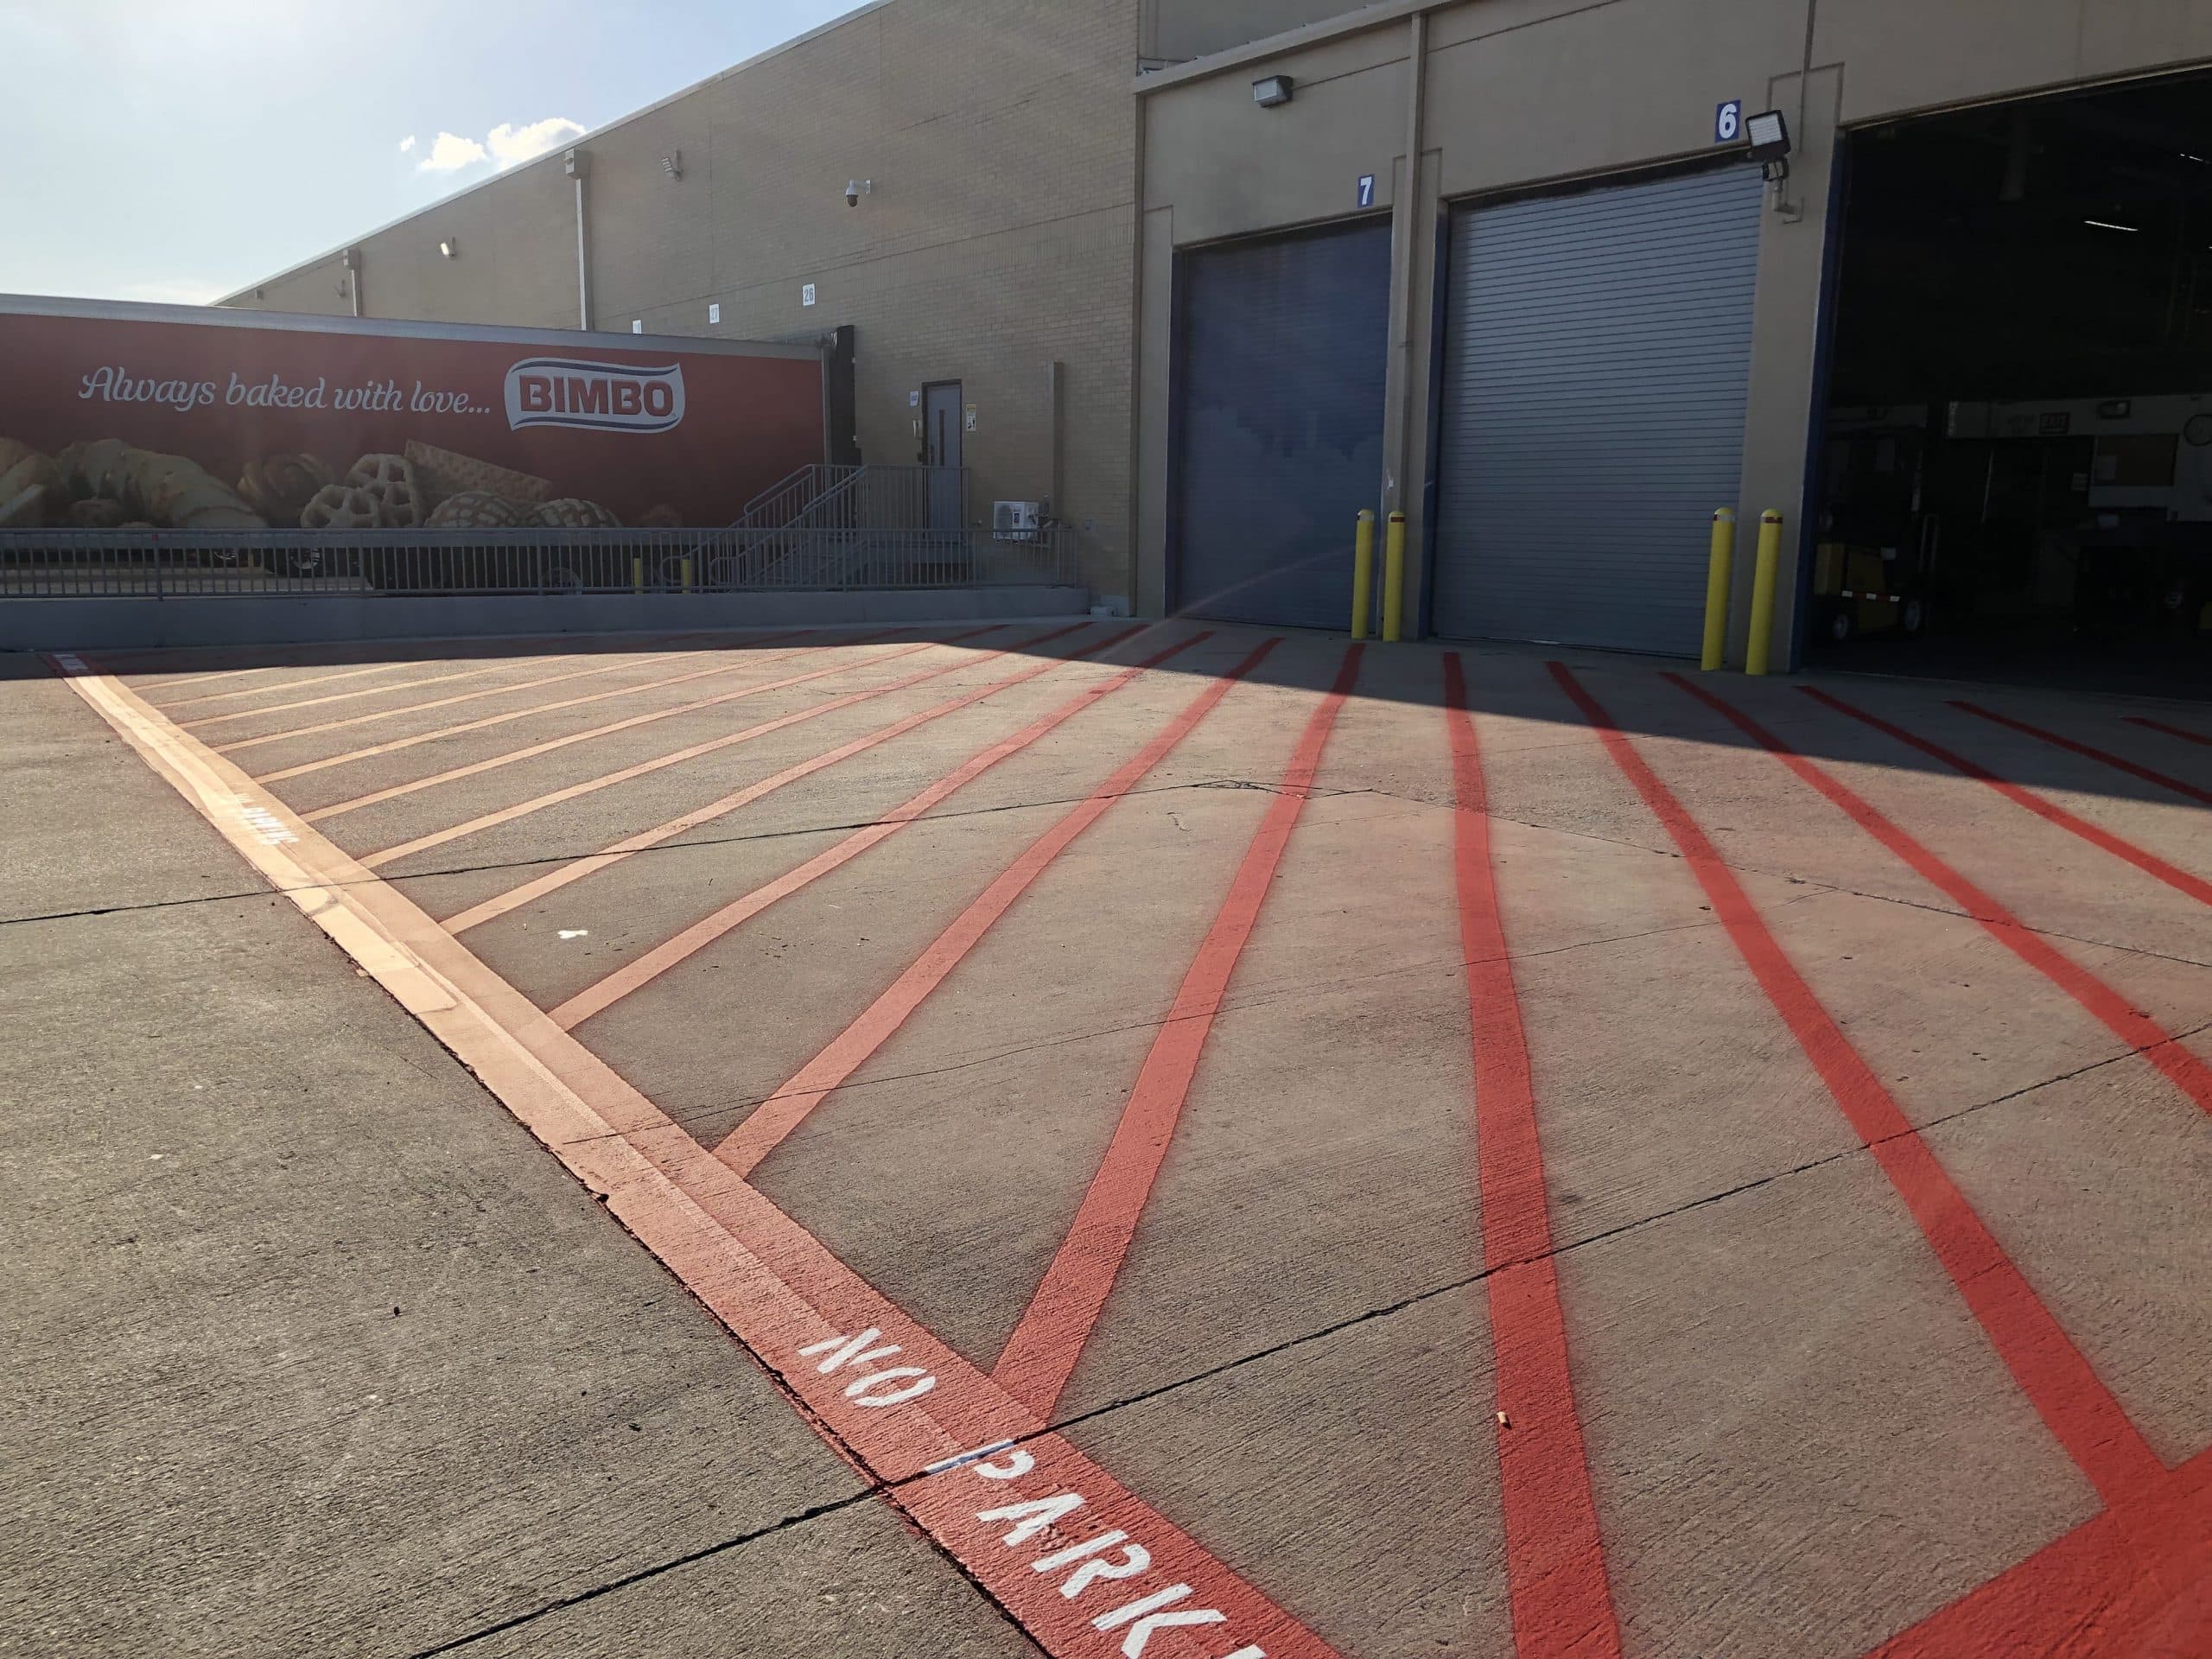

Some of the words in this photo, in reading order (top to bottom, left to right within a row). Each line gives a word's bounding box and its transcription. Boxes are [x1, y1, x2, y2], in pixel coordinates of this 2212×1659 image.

[1719, 103, 1737, 139] 6
[1360, 176, 1372, 206] 7
[804, 287, 814, 302] 26
[78, 366, 217, 411] Always
[225, 372, 327, 409] baked
[334, 379, 404, 411] with
[410, 380, 491, 413] love...
[519, 375, 674, 417] BIMBO
[798, 1327, 937, 1408] NO
